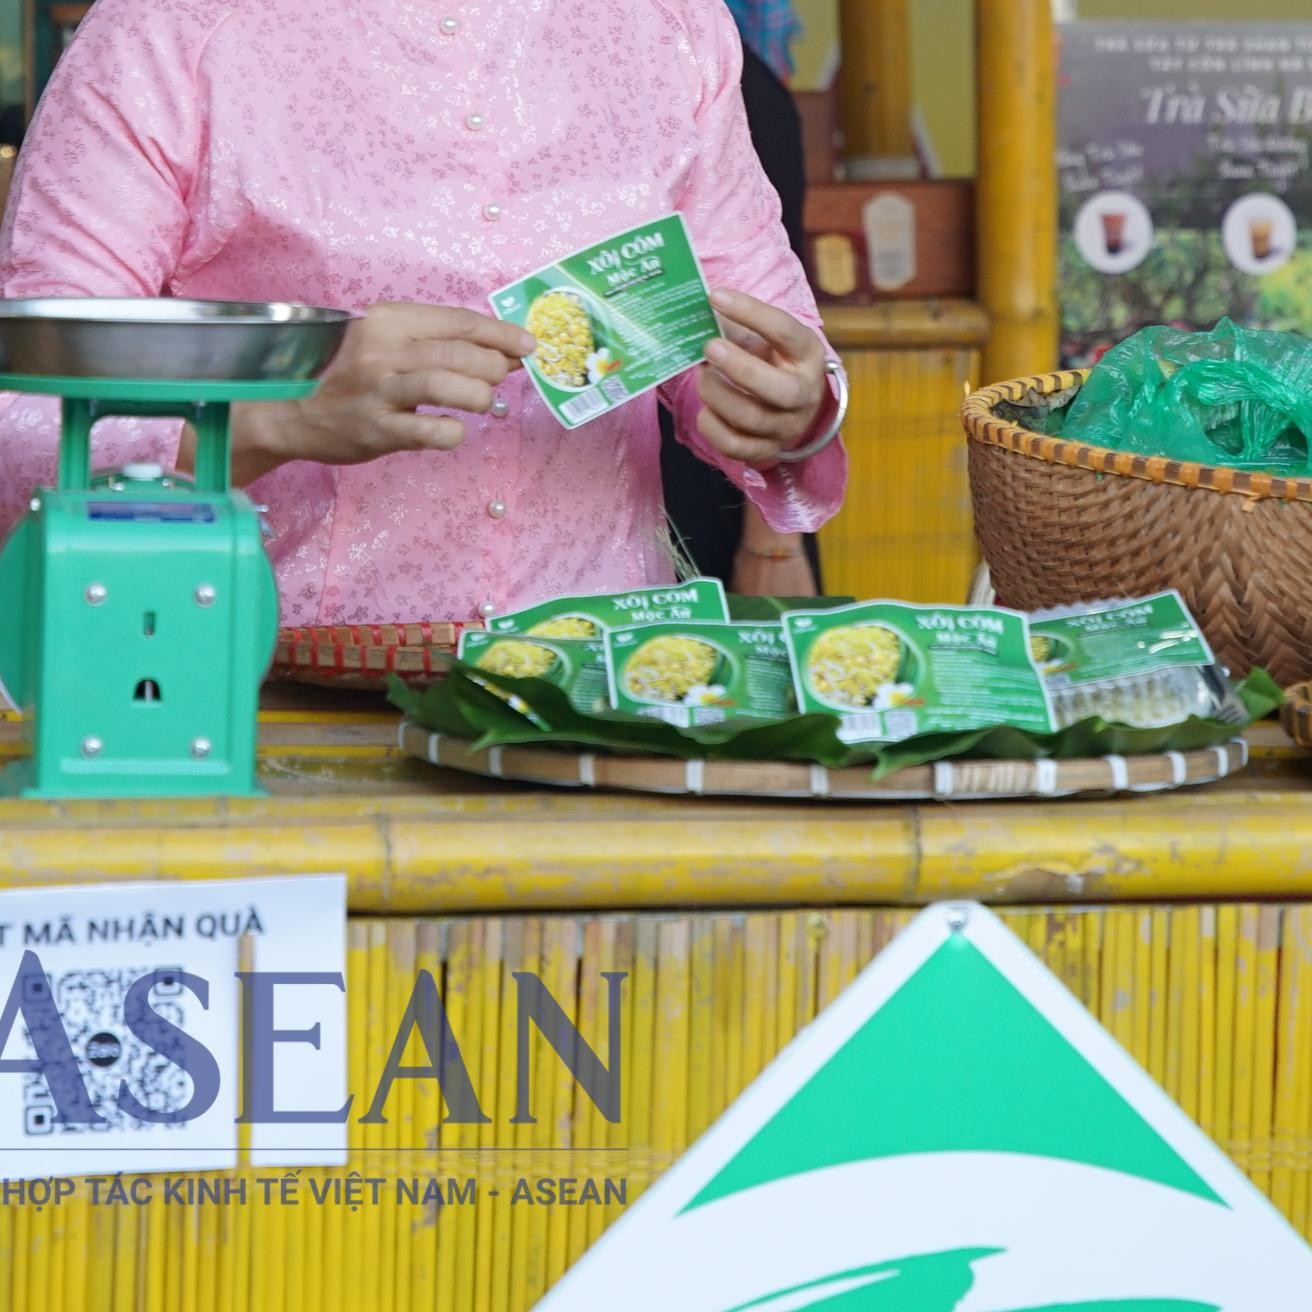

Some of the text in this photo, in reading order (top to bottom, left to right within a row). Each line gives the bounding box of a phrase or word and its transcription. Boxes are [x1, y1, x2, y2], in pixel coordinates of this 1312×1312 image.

[23, 917, 75, 946] MÃ
[89, 913, 184, 947] NHẬN
[196, 905, 264, 938] QUÀ
